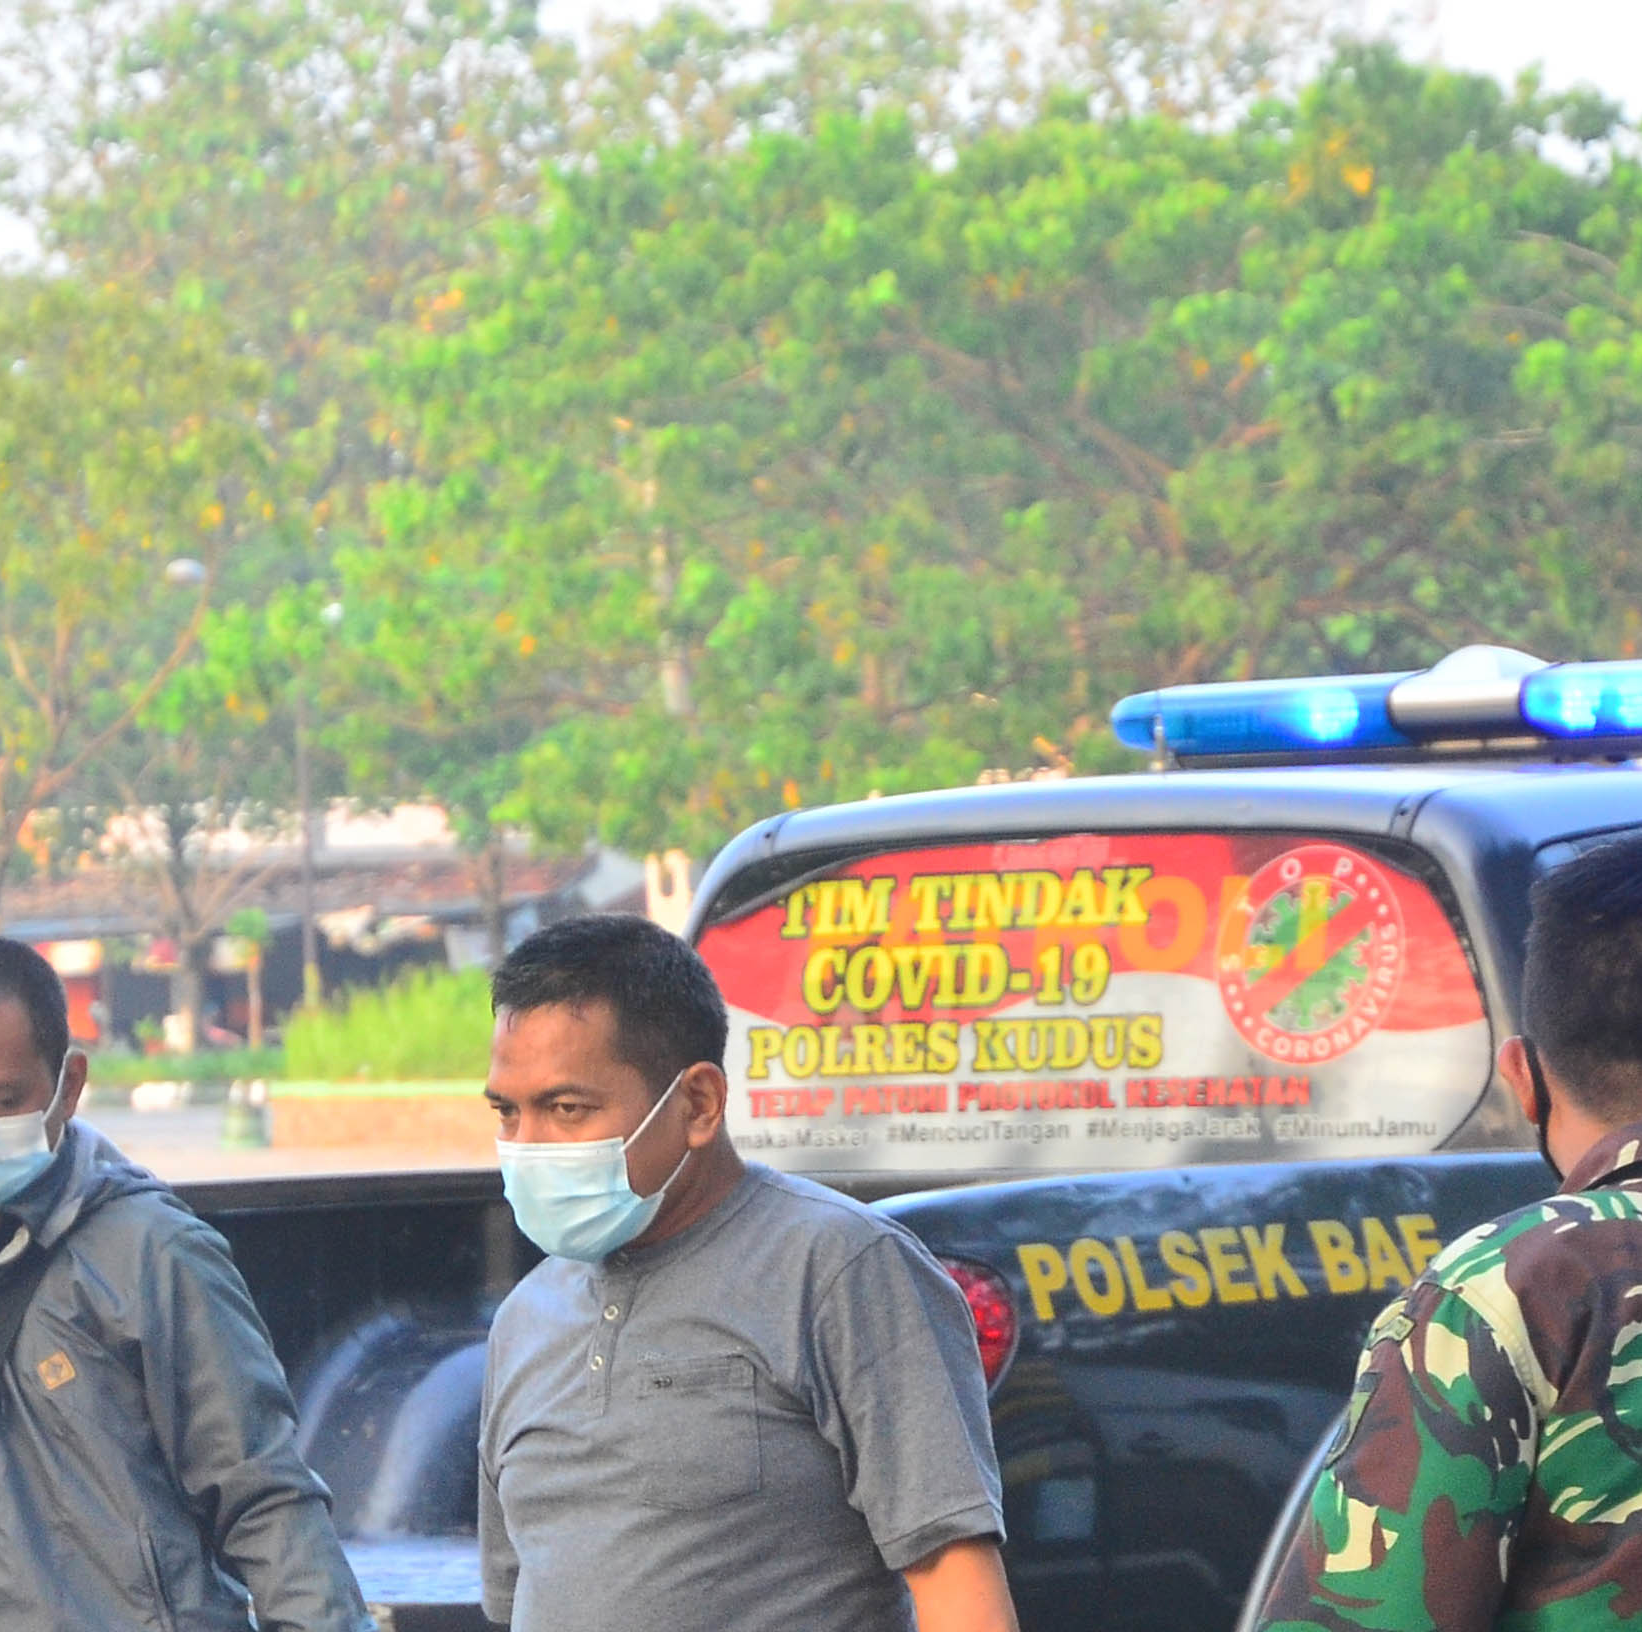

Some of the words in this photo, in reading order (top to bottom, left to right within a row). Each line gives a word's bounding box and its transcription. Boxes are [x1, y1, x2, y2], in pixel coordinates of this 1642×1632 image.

[779, 876, 896, 939] TIM
[910, 864, 1154, 932] TINDAK
[801, 941, 1111, 1014] COVID-19
[1256, 922, 1398, 1058] CORONAVIRUS
[747, 1020, 959, 1080] POLRES
[973, 1013, 1164, 1073] KUDUS
[733, 1126, 870, 1149] makaiMasker
[885, 1118, 1070, 1144] #MencuciTangan
[1086, 1116, 1262, 1142] #MenjagaJarak
[1274, 1115, 1438, 1140] #MinumJamu
[748, 1087, 835, 1118] TETAP
[844, 1083, 949, 1116] PATUHI
[957, 1080, 1117, 1111] PROTOKOL
[1125, 1076, 1311, 1108] KESEHATAN
[1016, 1222, 1308, 1323] POLSEK
